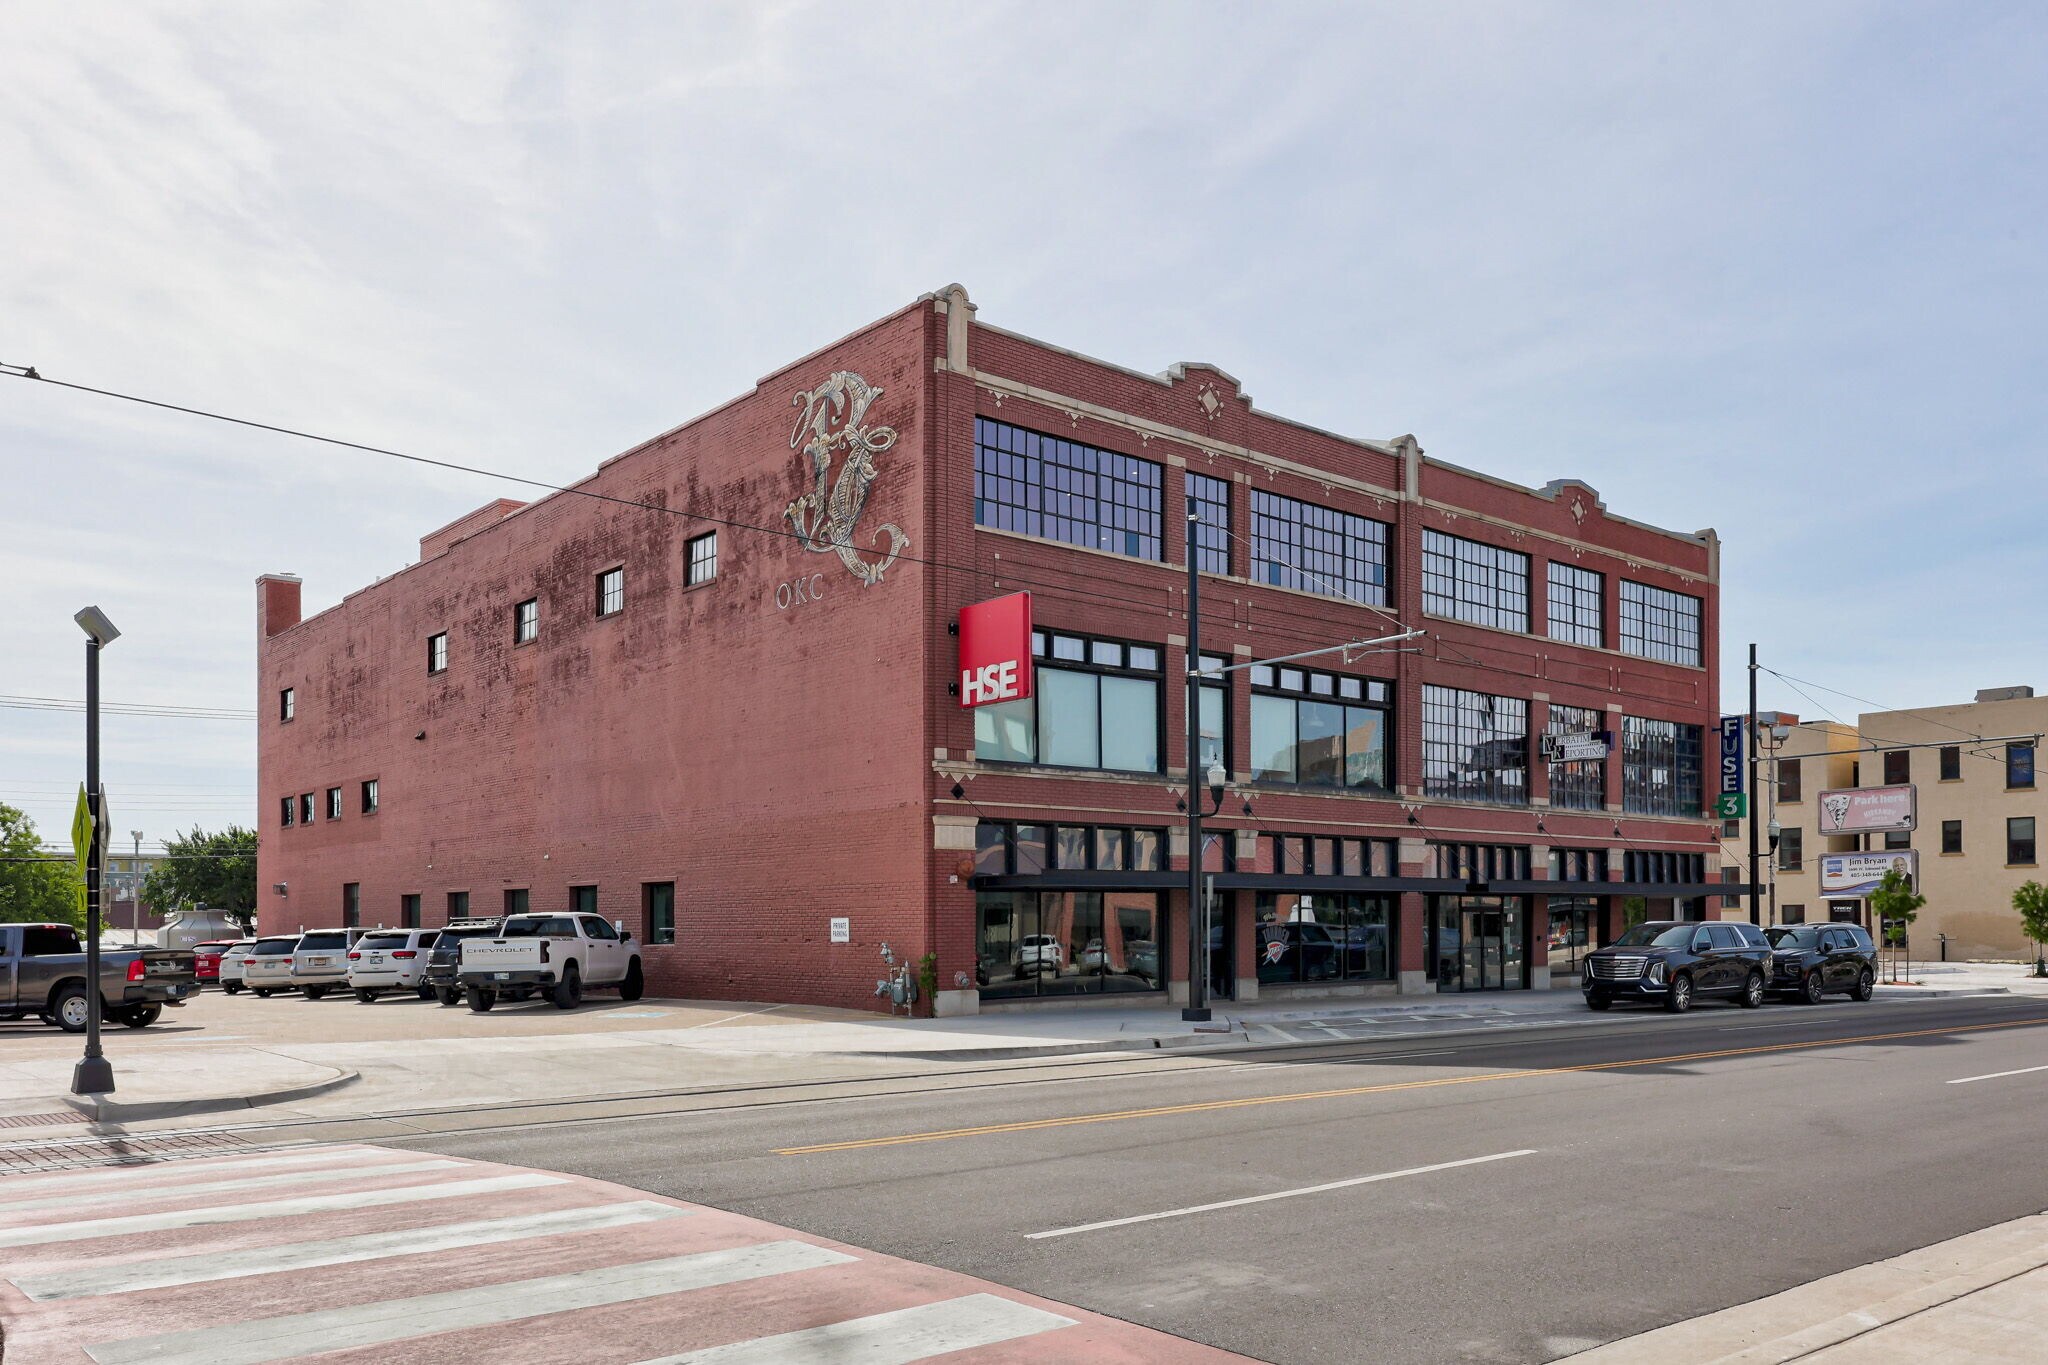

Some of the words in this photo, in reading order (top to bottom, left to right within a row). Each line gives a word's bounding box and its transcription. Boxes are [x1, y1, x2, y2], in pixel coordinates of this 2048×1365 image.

[776, 573, 823, 609] OKC
[963, 660, 1018, 705] HSE
[1545, 735, 1590, 751] VERBATIM
[1553, 745, 1604, 759] REPORTING
[1723, 719, 1738, 792] FUSE
[1723, 796, 1738, 815] 3
[1854, 795, 1878, 805] Park
[1849, 858, 1862, 866] Jim
[1864, 857, 1887, 866] Bryan
